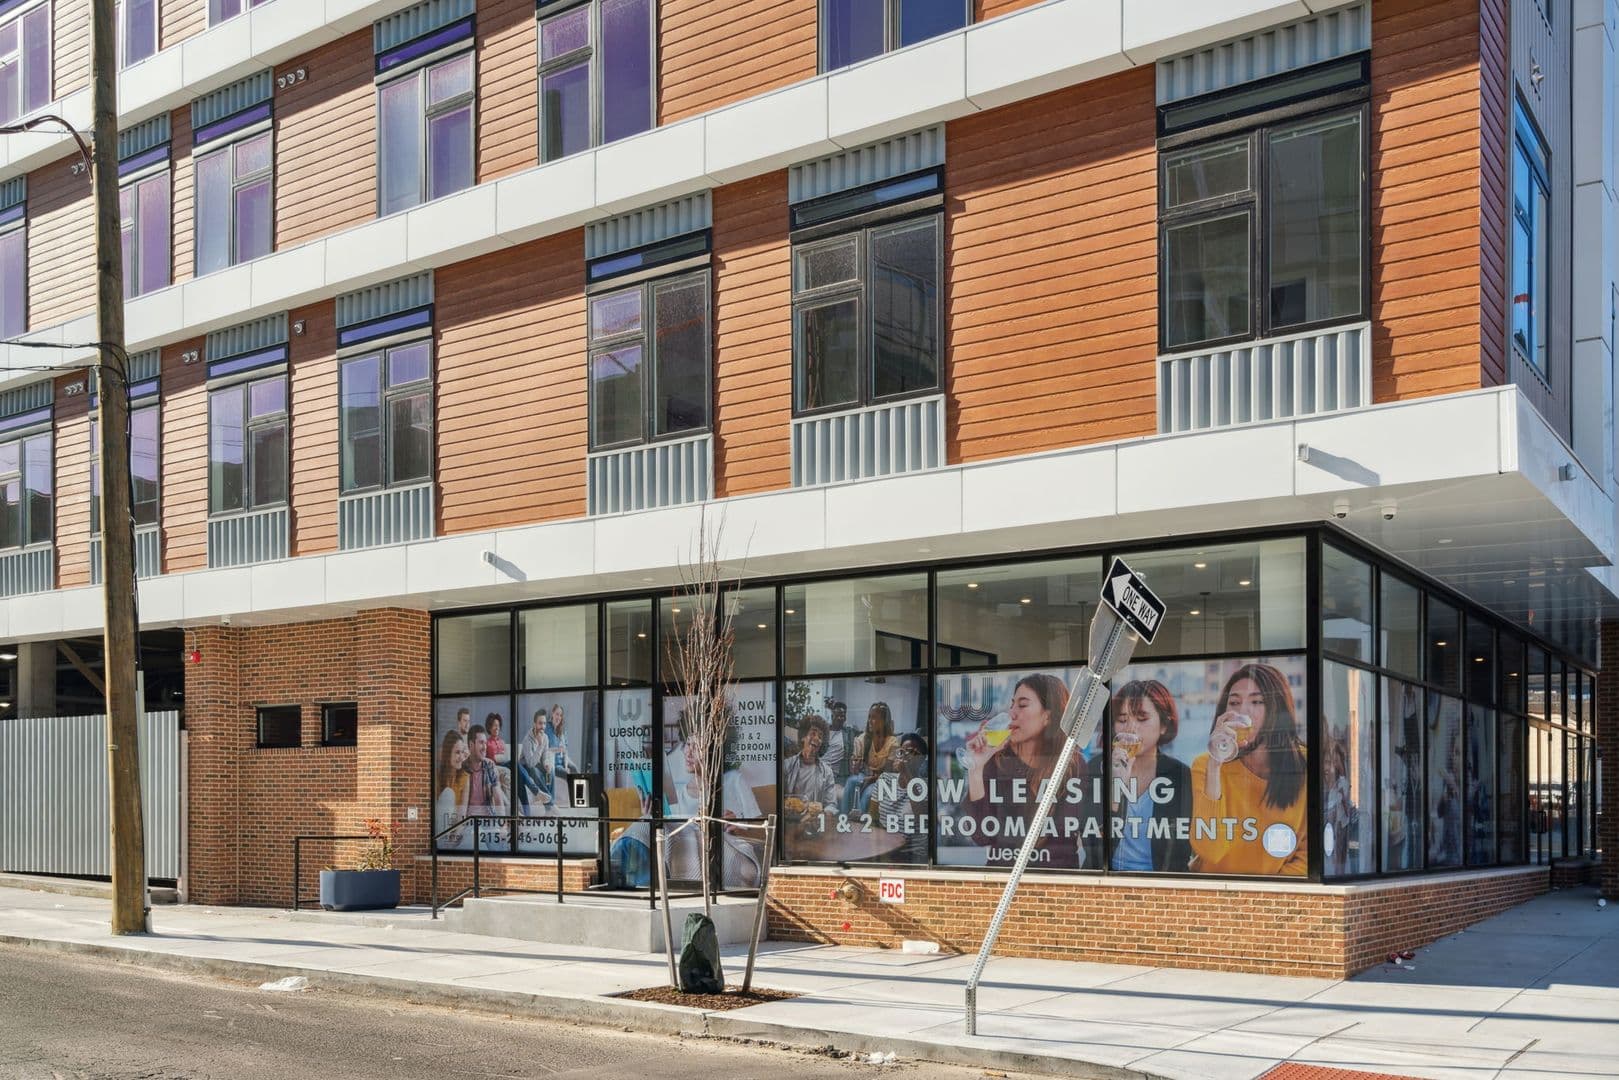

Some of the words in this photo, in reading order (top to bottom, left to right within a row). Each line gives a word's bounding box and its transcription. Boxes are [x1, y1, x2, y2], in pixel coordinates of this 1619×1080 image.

[1122, 586, 1140, 611] ONE
[1137, 602, 1156, 626] WAY
[738, 700, 766, 711] NOW
[729, 714, 775, 726] LEASING
[609, 725, 651, 738] weston
[731, 743, 771, 752] BEDROOM
[616, 750, 646, 760] FRONT
[725, 753, 777, 762] APARTMENTS
[608, 762, 652, 772] ENTRANCE
[877, 777, 965, 804] NOW
[989, 777, 1175, 804] LEASING
[461, 816, 589, 828] IGHTORENTS.COM
[817, 814, 826, 832] 1
[836, 814, 852, 833] &
[860, 814, 873, 833] 2
[886, 814, 1026, 837] BEDROOM
[1039, 816, 1258, 841] APARTMENTS
[986, 847, 1050, 862] weson
[881, 882, 902, 898] FDC
